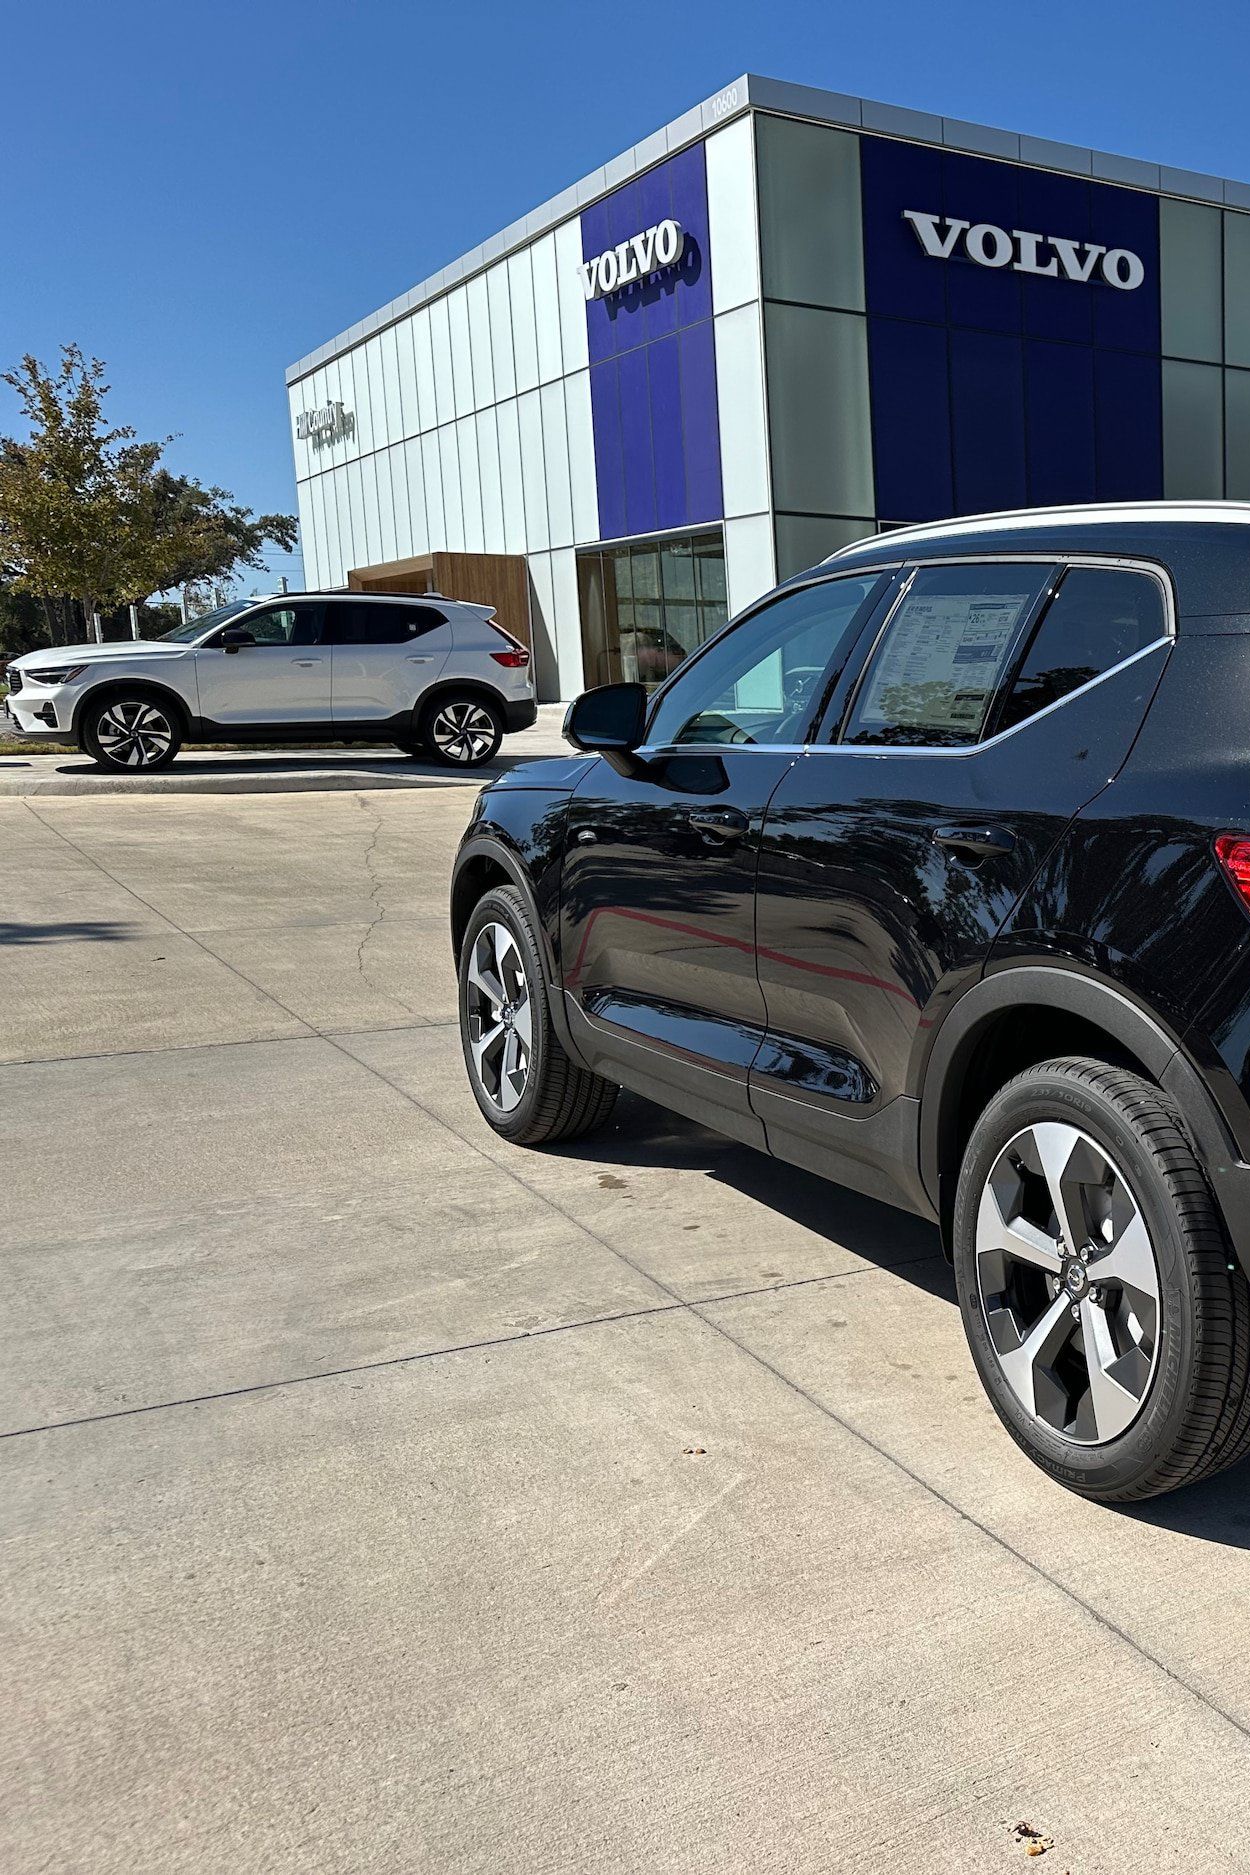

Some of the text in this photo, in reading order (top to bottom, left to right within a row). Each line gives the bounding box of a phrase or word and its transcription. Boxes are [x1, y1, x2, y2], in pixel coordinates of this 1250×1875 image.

[711, 88, 738, 118] 10600
[577, 218, 681, 301] VOLVO
[902, 209, 1146, 291] VOLVO
